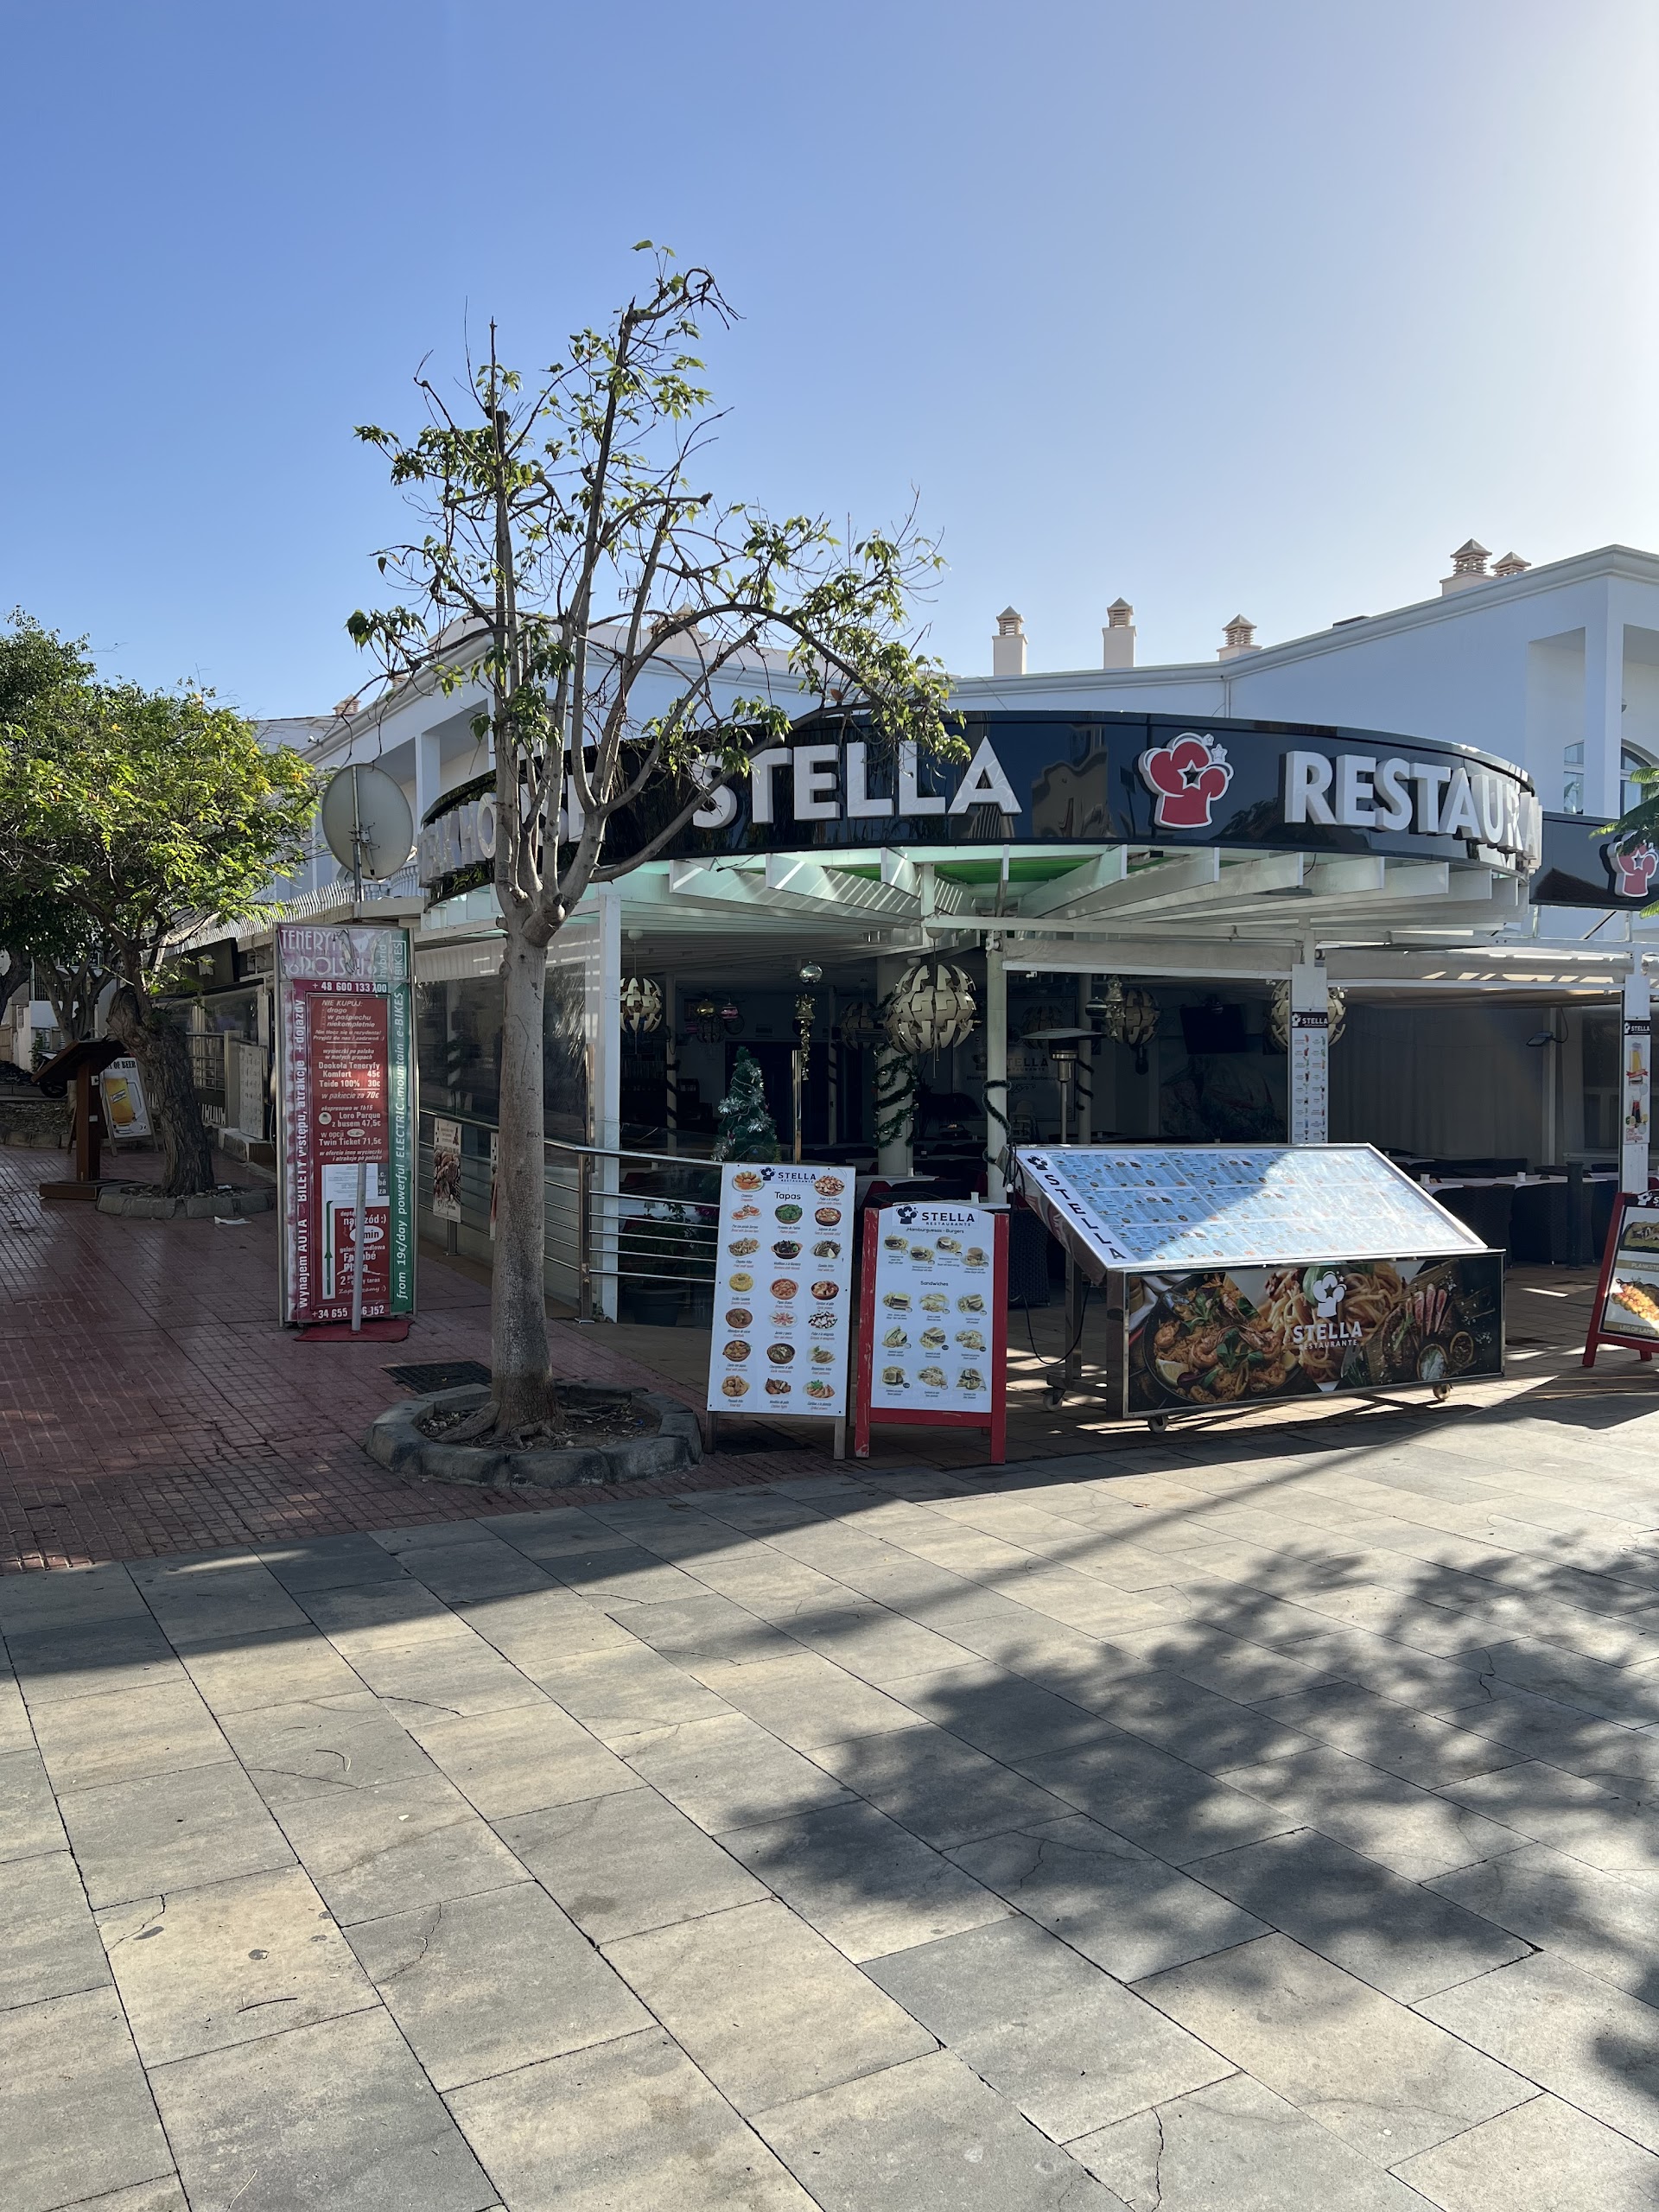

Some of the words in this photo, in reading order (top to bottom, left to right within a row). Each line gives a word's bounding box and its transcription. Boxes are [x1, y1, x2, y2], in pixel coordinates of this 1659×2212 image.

[691, 736, 1022, 830] STELLA
[378, 944, 386, 977] hybrid
[321, 982, 332, 991] 48
[336, 982, 352, 991] 600
[355, 982, 370, 992] 133
[393, 992, 404, 1037] e-BIKES
[121, 1060, 137, 1069] BEER
[349, 1062, 380, 1071] Teneryfy
[1007, 1058, 1048, 1067] TELLA
[296, 1060, 307, 1108] atrakcje
[329, 1091, 355, 1100] pakiecie
[356, 1112, 380, 1121] Parque
[395, 1103, 405, 1158] ELECTRIC
[778, 1172, 817, 1180] STELLA
[396, 1163, 407, 1215] powerful
[774, 1191, 802, 1201] Tapas
[343, 1214, 379, 1225] nazód
[921, 1212, 976, 1223] STELLA
[396, 1220, 407, 1266] 19€/day
[1630, 1262, 1659, 1271] PLANKSTE
[298, 1255, 309, 1308] wynajem
[340, 1275, 346, 1286] 2
[397, 1272, 408, 1300] from
[331, 1307, 348, 1318] 655
[1293, 1320, 1363, 1344] STELLA
[1299, 1339, 1357, 1351] RESTAURANTE
